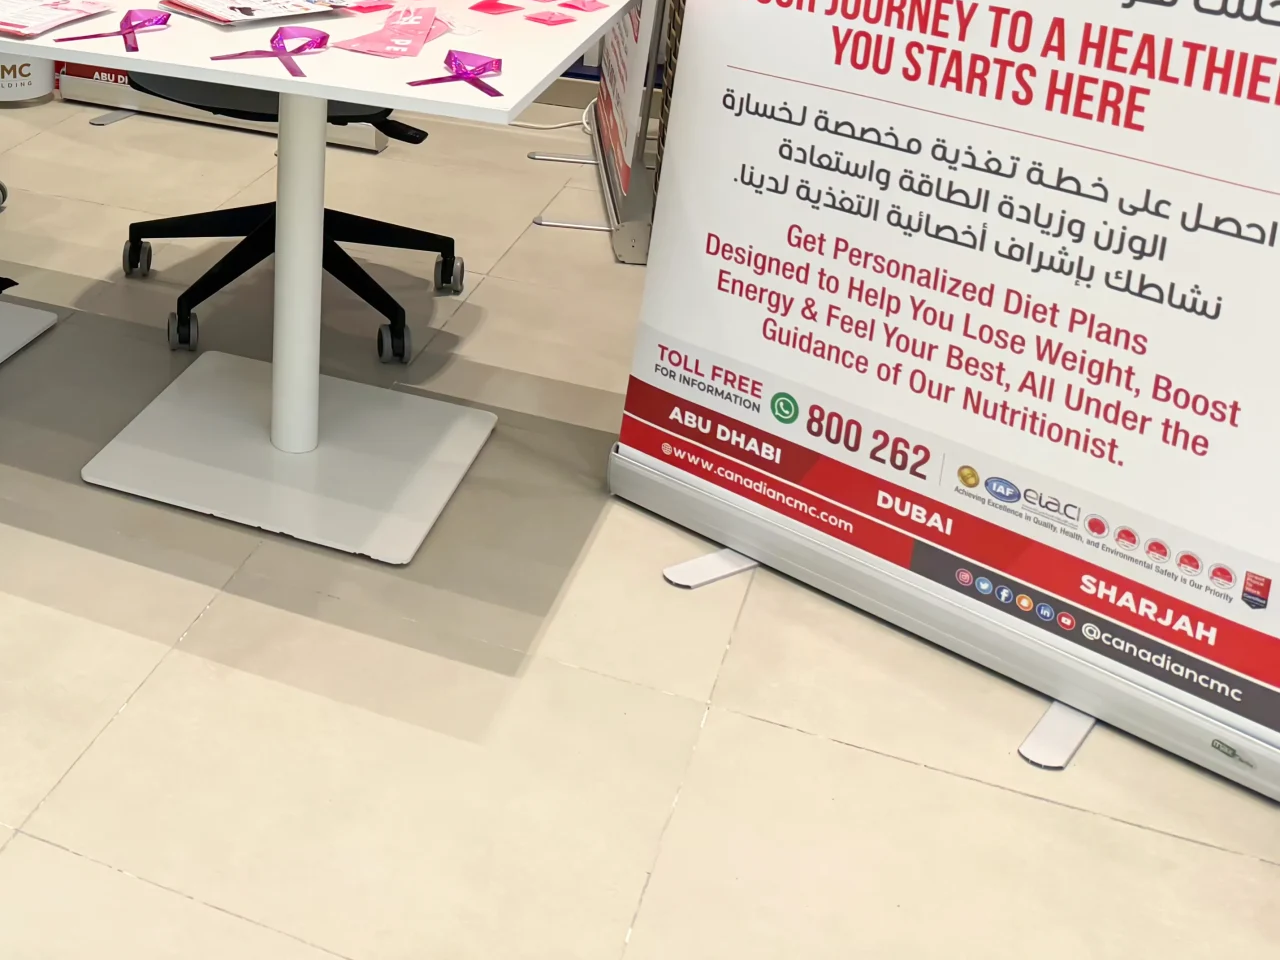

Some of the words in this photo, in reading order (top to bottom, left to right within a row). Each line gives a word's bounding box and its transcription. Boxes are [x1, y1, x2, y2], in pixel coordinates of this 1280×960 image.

[832, 25, 895, 75] YOU
[902, 41, 1037, 106] STARTS
[1045, 69, 1151, 132] HERE
[988, 5, 1033, 53] TO
[1040, 17, 1065, 61] A
[1078, 22, 1280, 106] HEALTHIE
[722, 88, 807, 126] لخسارة
[814, 109, 922, 155] مخصصة
[779, 138, 891, 191] واستعادة
[931, 138, 1020, 178] تغذية
[1026, 161, 1108, 203] خطة
[796, 179, 880, 221] التغذية
[899, 169, 990, 212] الطاقة
[1118, 189, 1172, 220] على
[886, 204, 988, 252] أخصائية
[998, 194, 1085, 243] وزيادة
[1094, 221, 1167, 261] الوزن
[1180, 202, 1278, 247] احصل
[994, 237, 1095, 288] بإشراف
[787, 224, 826, 256] Get
[833, 237, 995, 308] Personalized
[1003, 288, 1060, 328] Diet
[1068, 308, 1148, 355] Plans
[1104, 269, 1222, 320] نشاطك
[706, 233, 810, 285] Designed
[818, 268, 839, 294] to
[848, 276, 901, 317] Help
[910, 295, 954, 332] You
[963, 313, 1025, 354] Lose
[1036, 335, 1140, 398] Weight,
[1152, 374, 1241, 427] Boost
[658, 344, 705, 377] TOLL
[711, 365, 763, 399] FREE
[717, 269, 798, 320] Energy
[801, 297, 818, 322] &
[826, 304, 875, 341] Feel
[883, 322, 939, 361] Your
[946, 344, 1010, 392] Best,
[1017, 370, 1055, 402] All
[1065, 383, 1152, 435] Under
[1161, 418, 1209, 456] the
[655, 364, 676, 381] FOR
[679, 374, 760, 413] INFORMATION
[762, 318, 868, 374] Guidance
[877, 363, 903, 385] of
[909, 369, 955, 403] Our
[963, 386, 1123, 466] Nutritionist.
[669, 406, 712, 434] ABU
[716, 424, 781, 464] DHABI
[806, 404, 862, 452] 800
[869, 430, 930, 480] 262
[673, 447, 853, 533] www.canadiancmc.com
[877, 490, 953, 535] DUBAI
[992, 483, 1014, 497] IAF
[1080, 574, 1217, 646] SHARJAH
[1082, 623, 1242, 701] @canadiancmc
